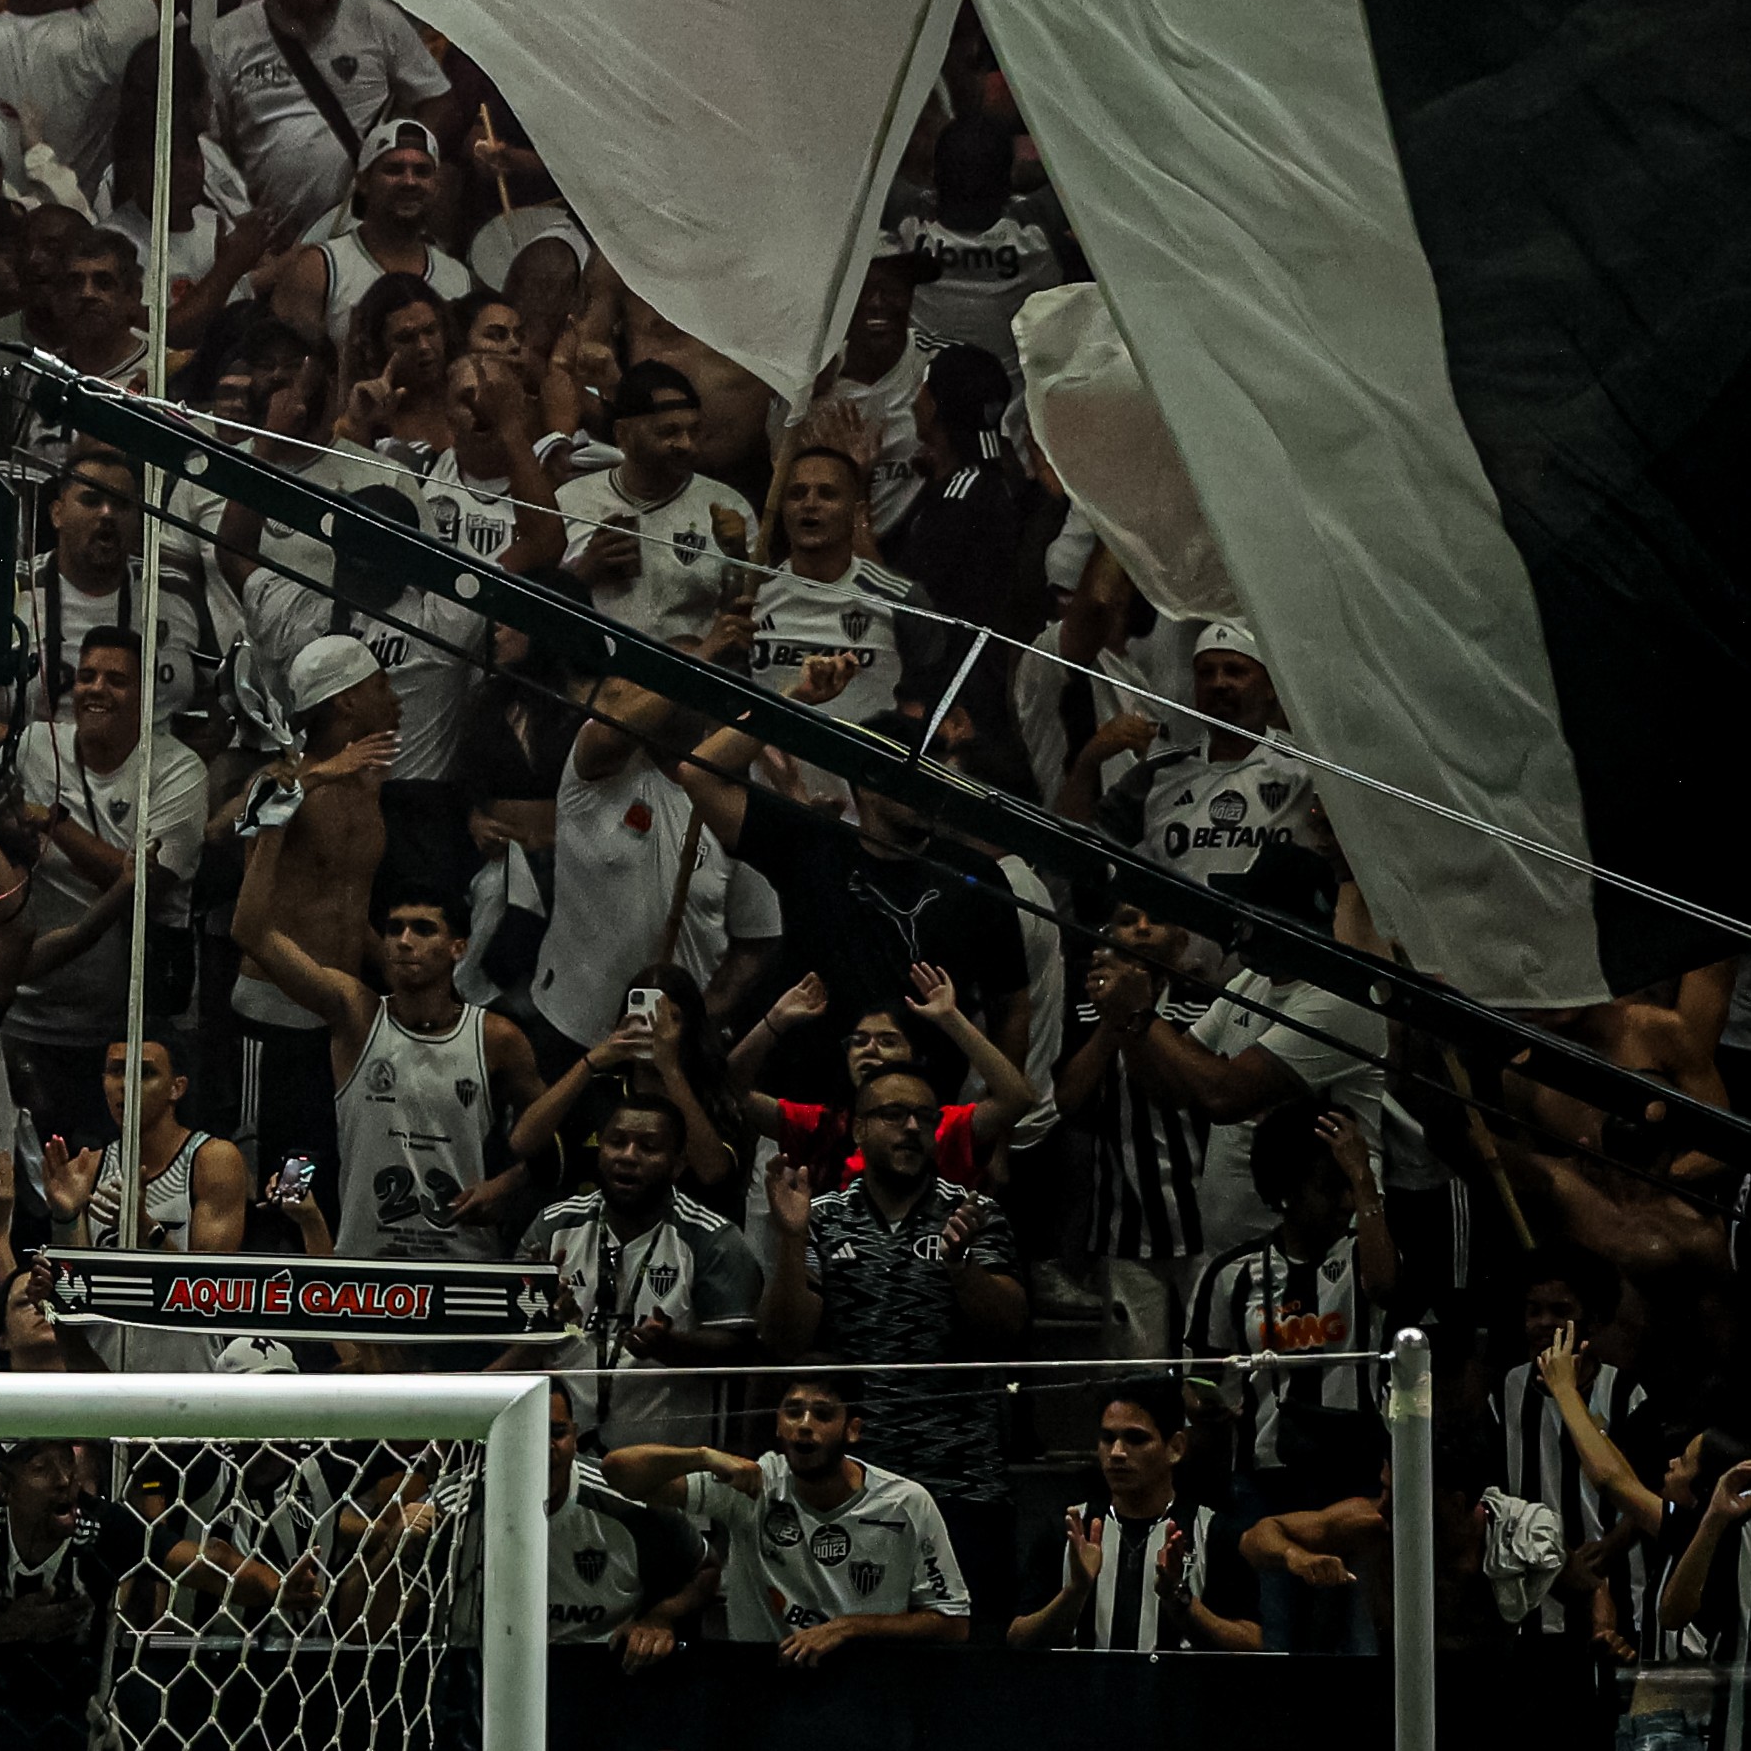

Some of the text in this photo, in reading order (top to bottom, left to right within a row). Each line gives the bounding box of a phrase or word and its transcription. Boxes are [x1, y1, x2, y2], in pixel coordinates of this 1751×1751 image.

[1192, 826, 1292, 850] BETANO
[165, 1269, 433, 1320] AQUI É GALO!
[923, 1556, 951, 1601] MRV
[548, 1604, 606, 1623] ANO
